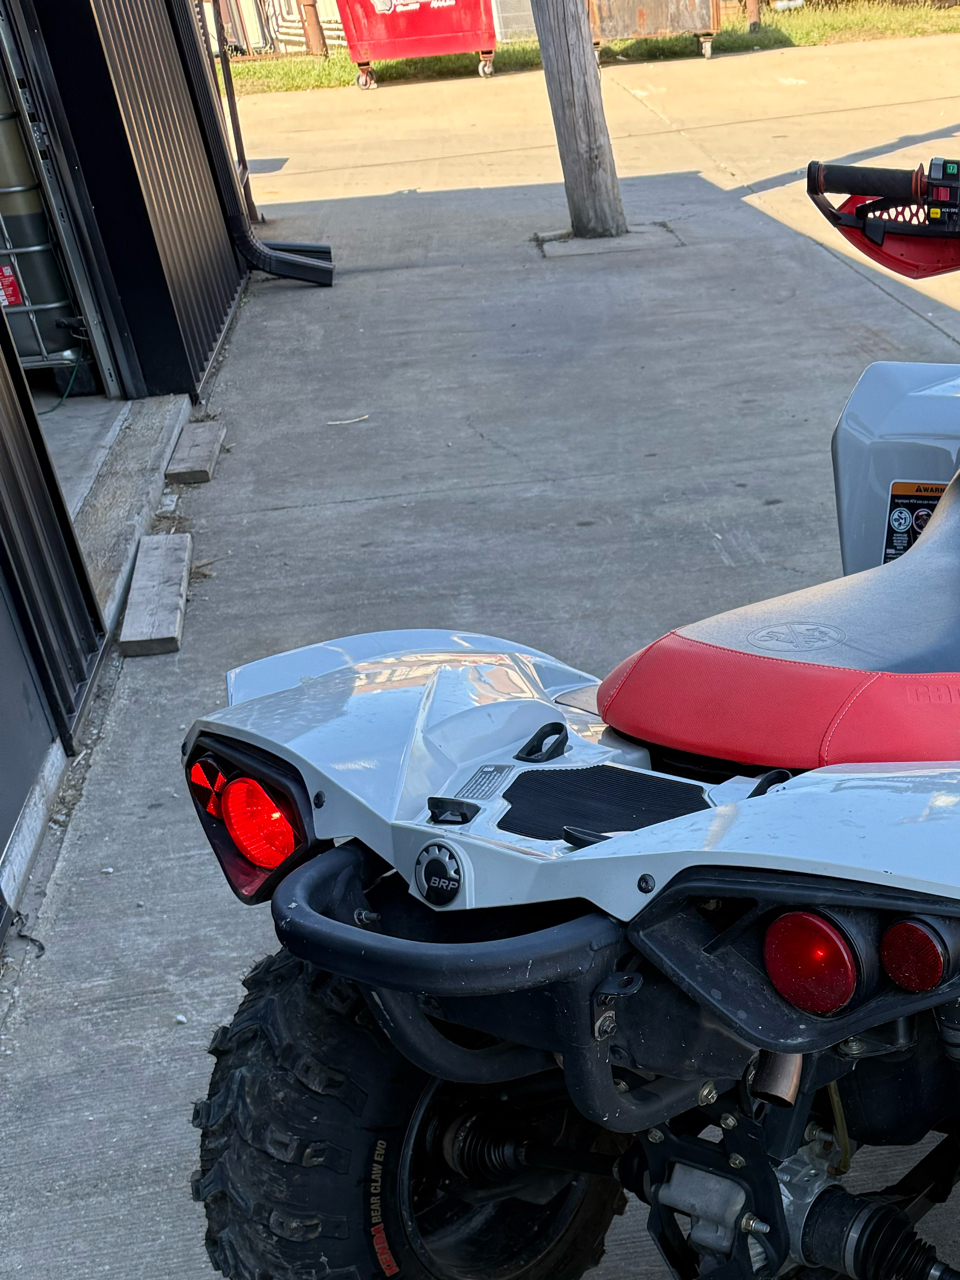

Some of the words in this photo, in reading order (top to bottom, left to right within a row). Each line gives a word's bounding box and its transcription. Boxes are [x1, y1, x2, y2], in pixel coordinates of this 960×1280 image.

[430, 876, 459, 891] BRP
[374, 1140, 387, 1161] EVO
[371, 1163, 382, 1193] CLAW
[370, 1196, 382, 1223] BEAR
[371, 1223, 400, 1277] KENDA
